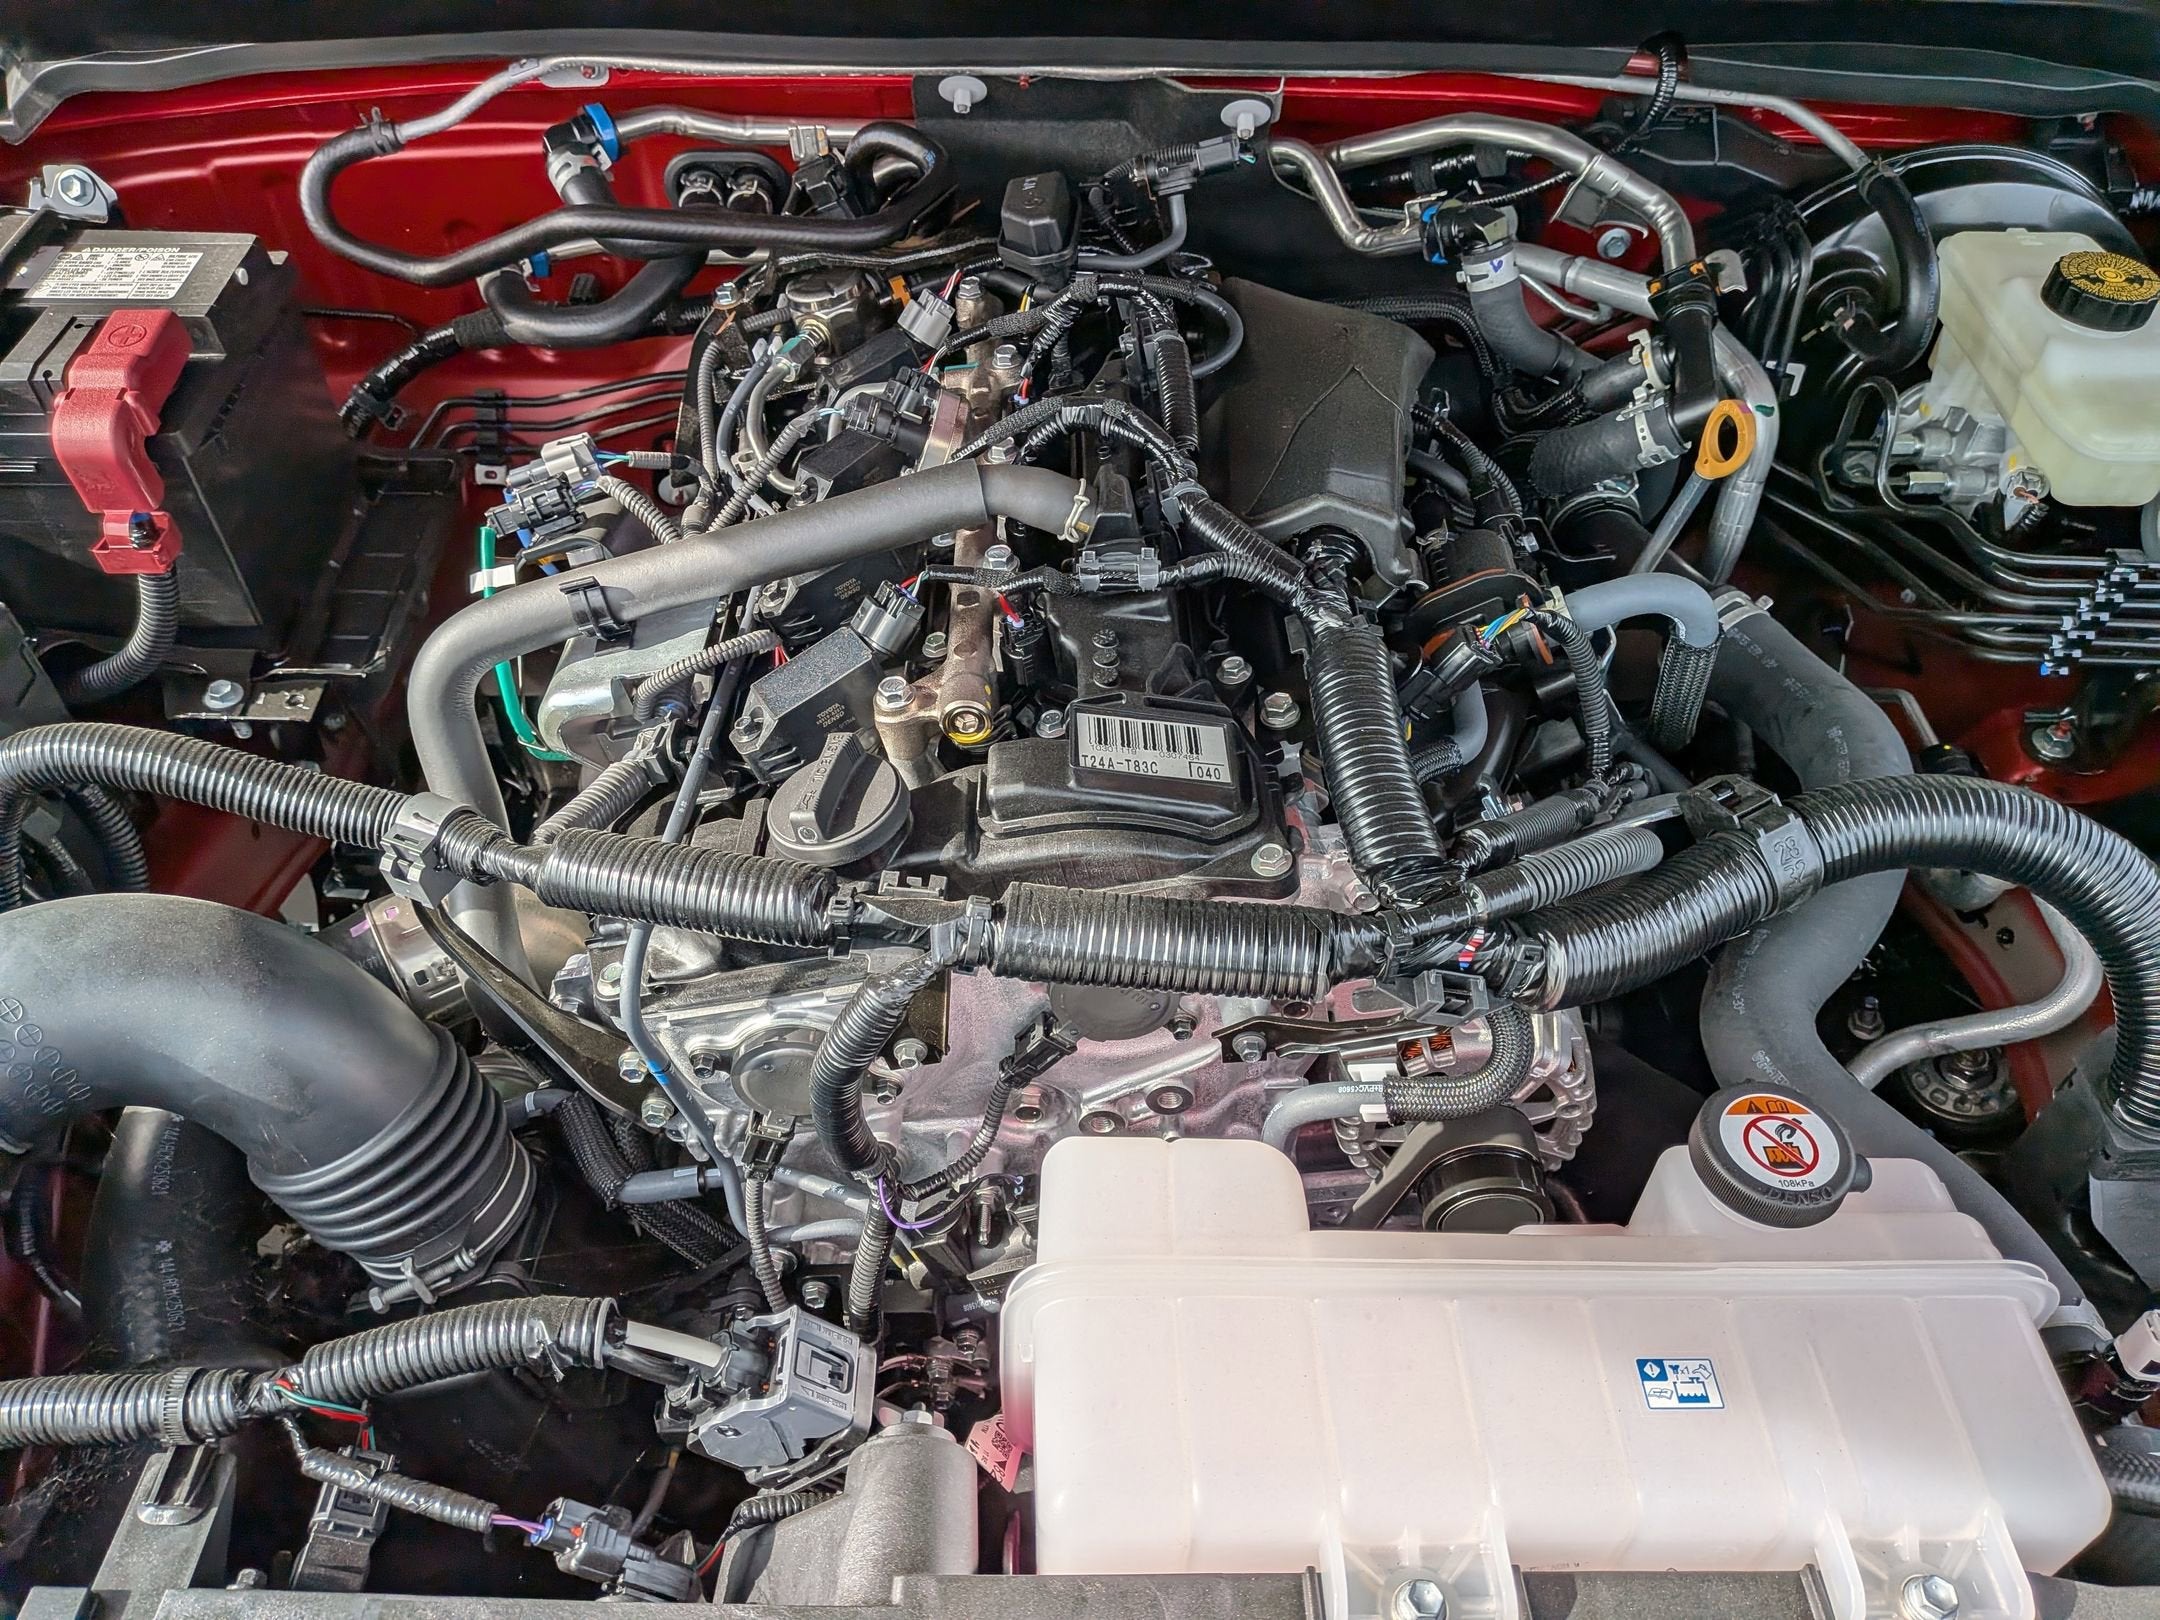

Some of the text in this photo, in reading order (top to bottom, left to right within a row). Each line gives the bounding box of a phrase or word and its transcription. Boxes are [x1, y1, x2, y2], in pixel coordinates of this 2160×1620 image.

[1081, 754, 1221, 780] T24A-T83C 040
[1777, 1178, 1815, 1189] 108kPa
[1764, 1186, 1833, 1207] DENSO
